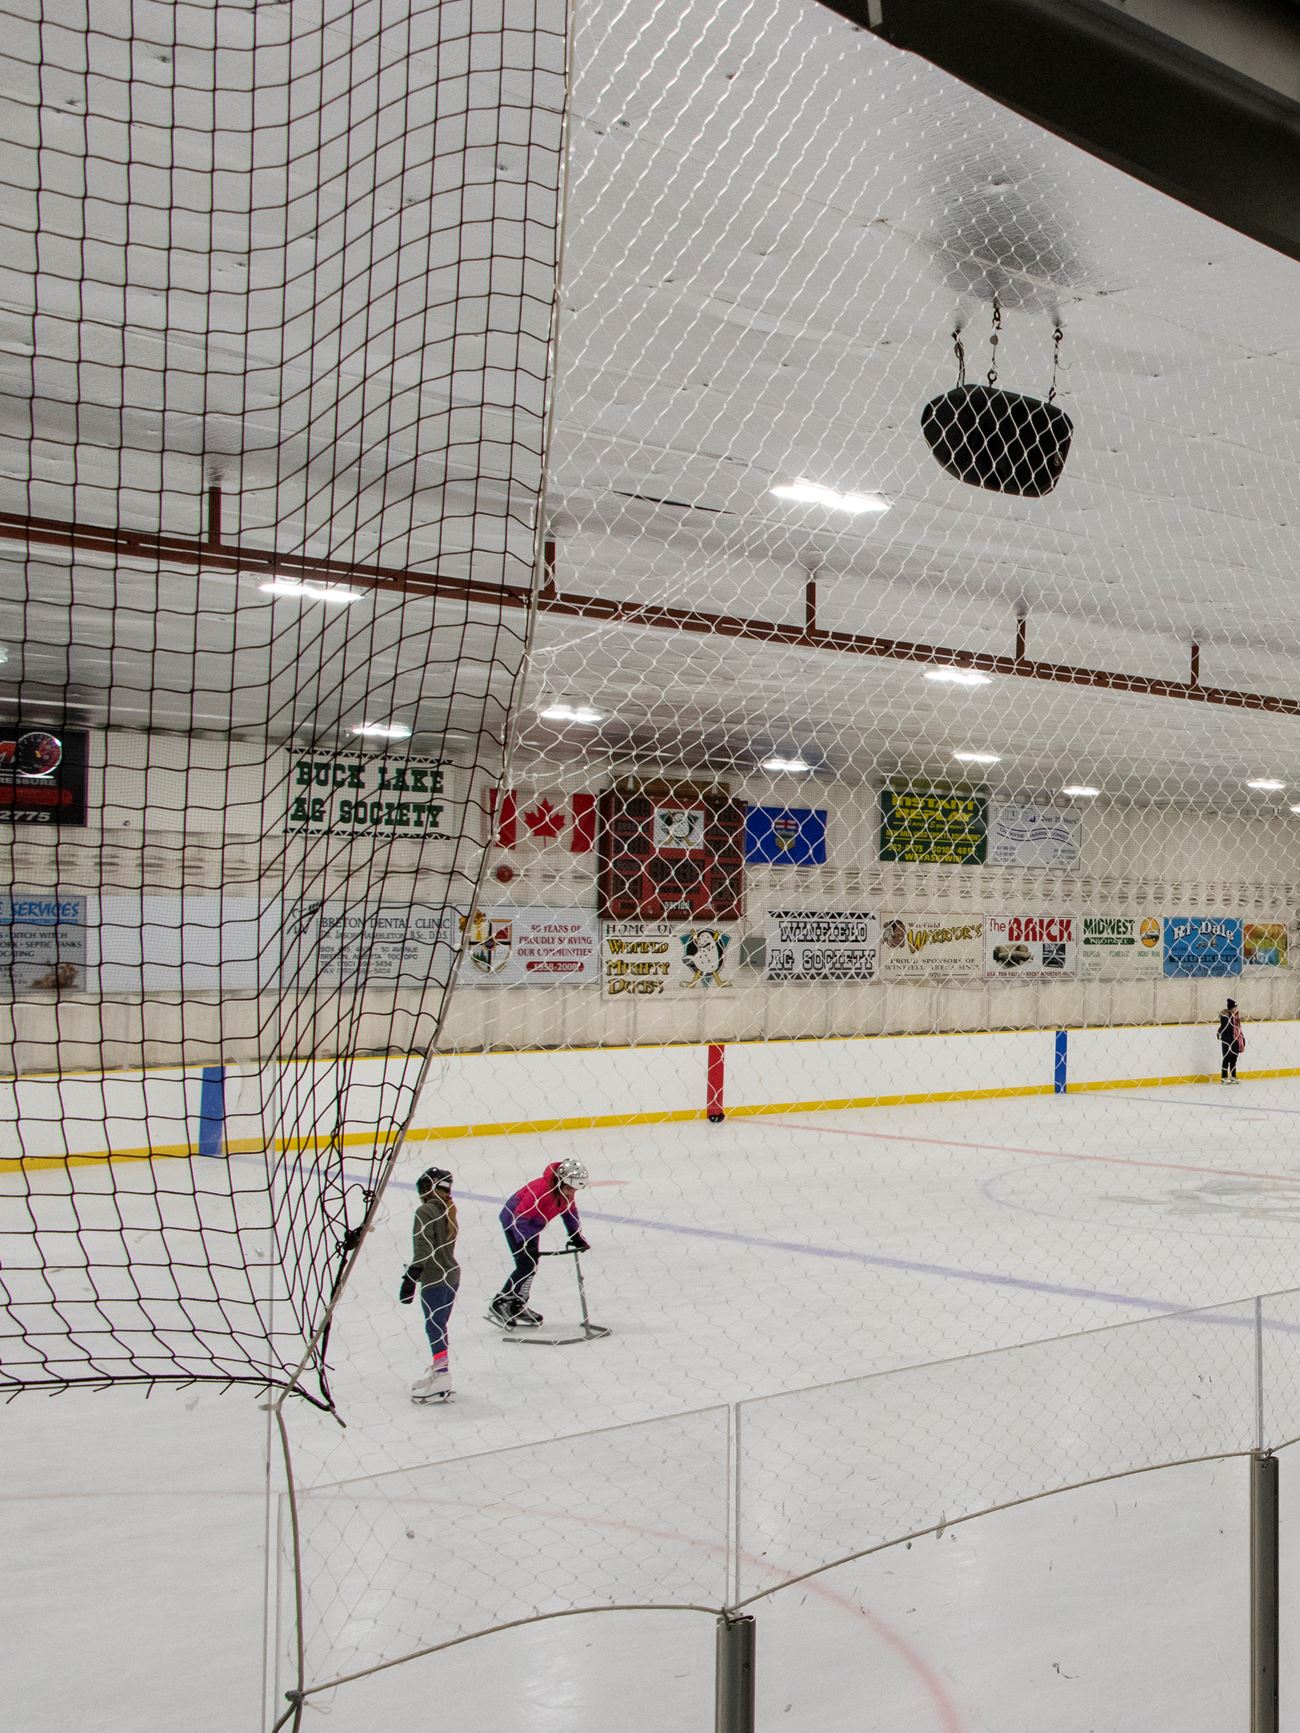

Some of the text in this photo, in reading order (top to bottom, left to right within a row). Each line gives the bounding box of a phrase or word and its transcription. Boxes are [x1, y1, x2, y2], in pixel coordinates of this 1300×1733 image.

[296, 761, 444, 793] BUCK LAKE
[290, 797, 444, 827] AG SOCIETY
[1008, 917, 1073, 942] BRICK
[1083, 918, 1135, 935] MIDWEST
[768, 948, 795, 971] AG
